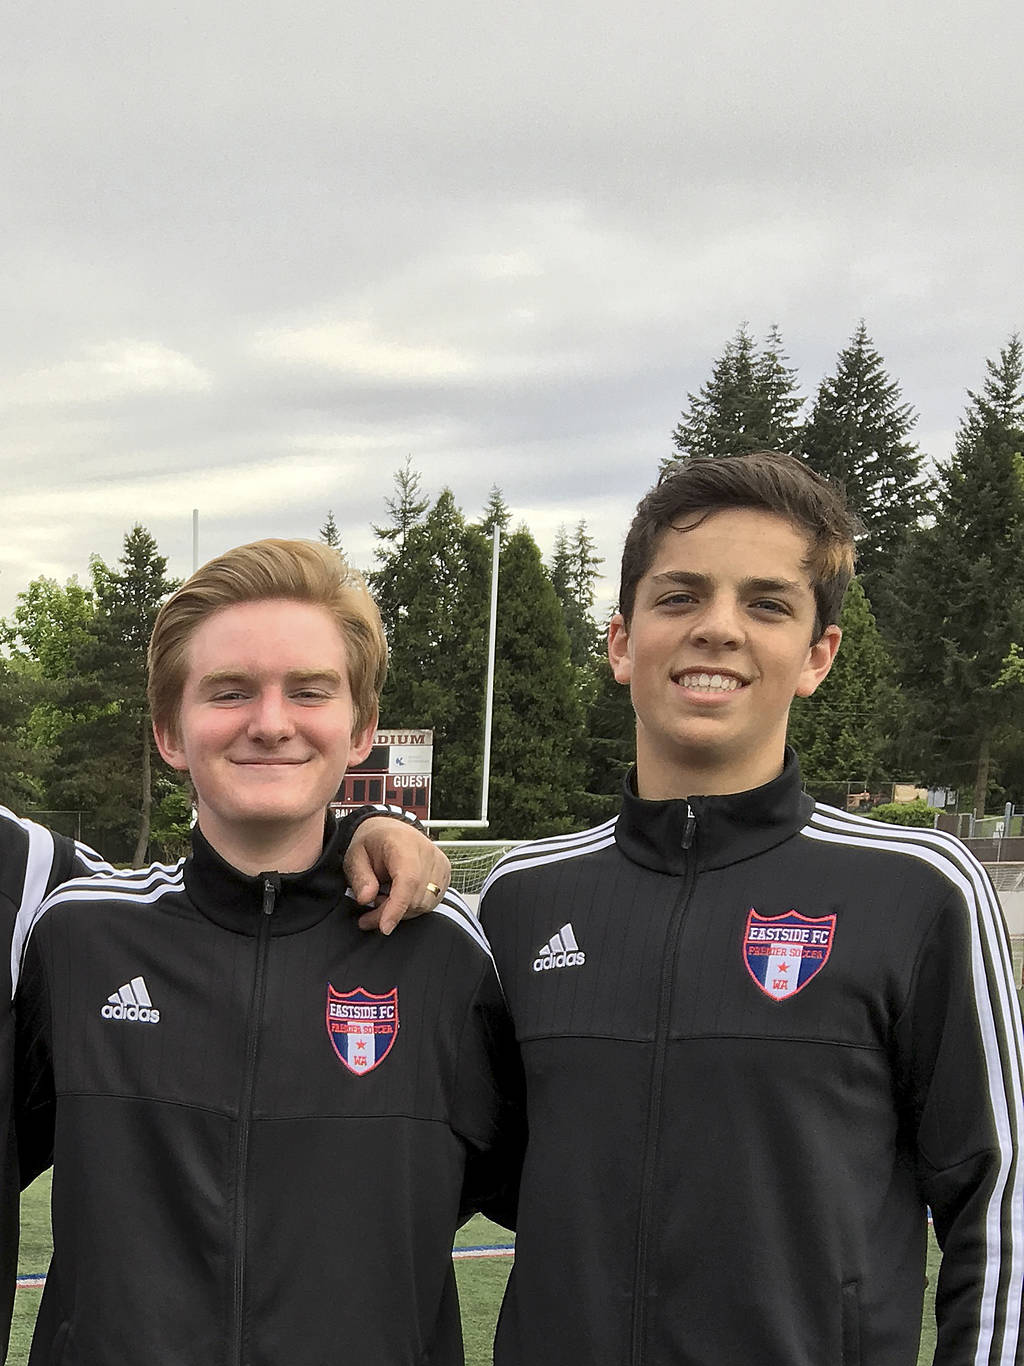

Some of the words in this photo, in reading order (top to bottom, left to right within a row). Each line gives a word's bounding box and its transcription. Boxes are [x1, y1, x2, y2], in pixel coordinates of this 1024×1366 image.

[393, 775, 430, 788] GUEST
[748, 927, 810, 942] EASTSIDE
[810, 930, 830, 944] FC
[748, 946, 787, 956] PREMIER
[789, 948, 824, 959] SOCCER
[533, 951, 586, 972] adidas
[772, 979, 788, 990] WA
[101, 1002, 161, 1024] adidas
[329, 1003, 378, 1019] EASTSIDE
[379, 1006, 395, 1019] FC
[353, 1055, 367, 1066] WA
